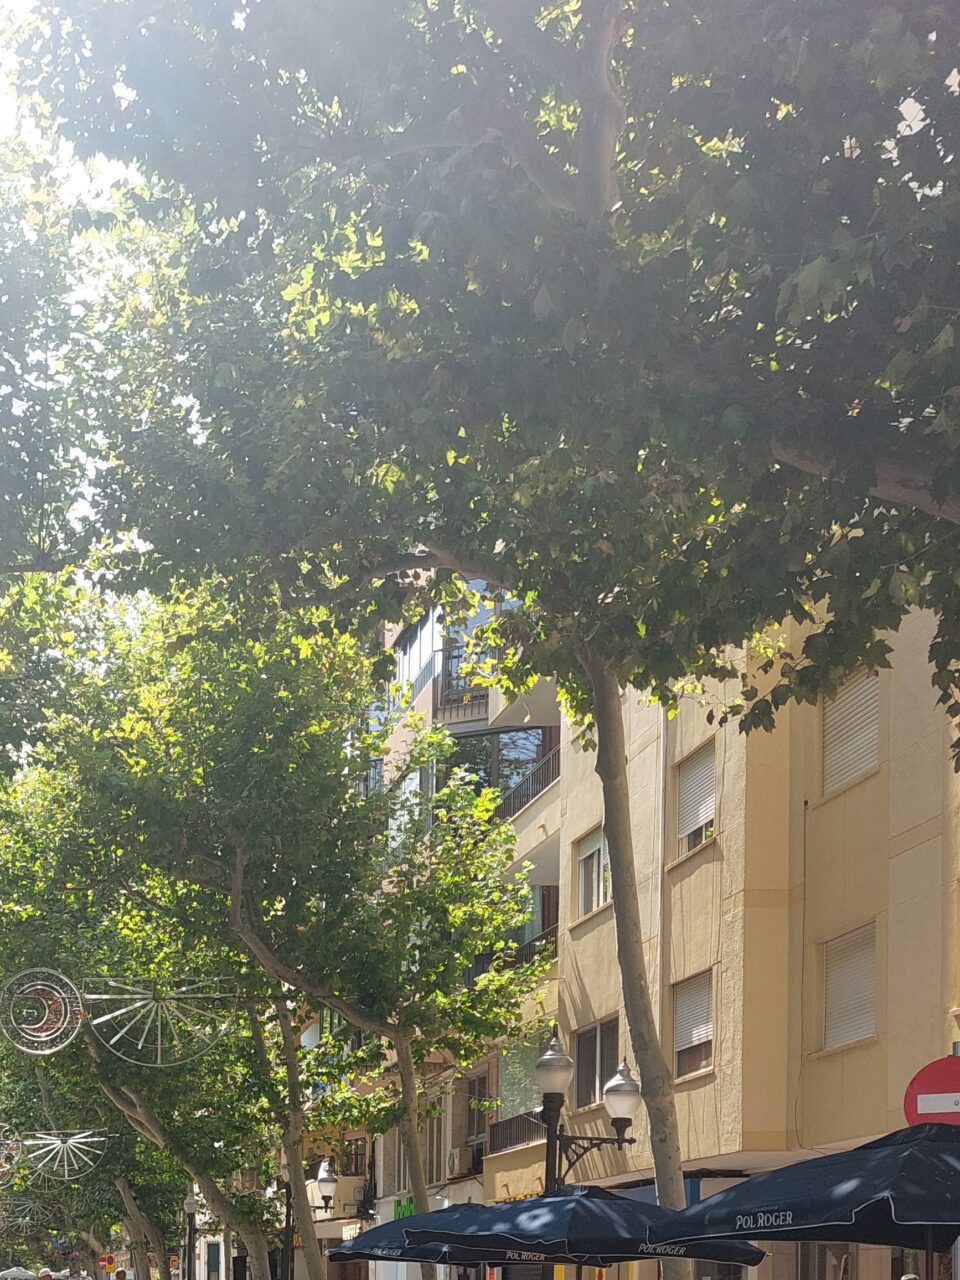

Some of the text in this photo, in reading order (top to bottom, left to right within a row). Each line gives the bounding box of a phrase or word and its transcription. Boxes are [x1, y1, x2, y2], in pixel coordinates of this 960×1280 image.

[735, 1210, 793, 1230] POL ROGER
[655, 1245, 687, 1255] ROGER
[506, 1251, 545, 1261] POL ROGER
